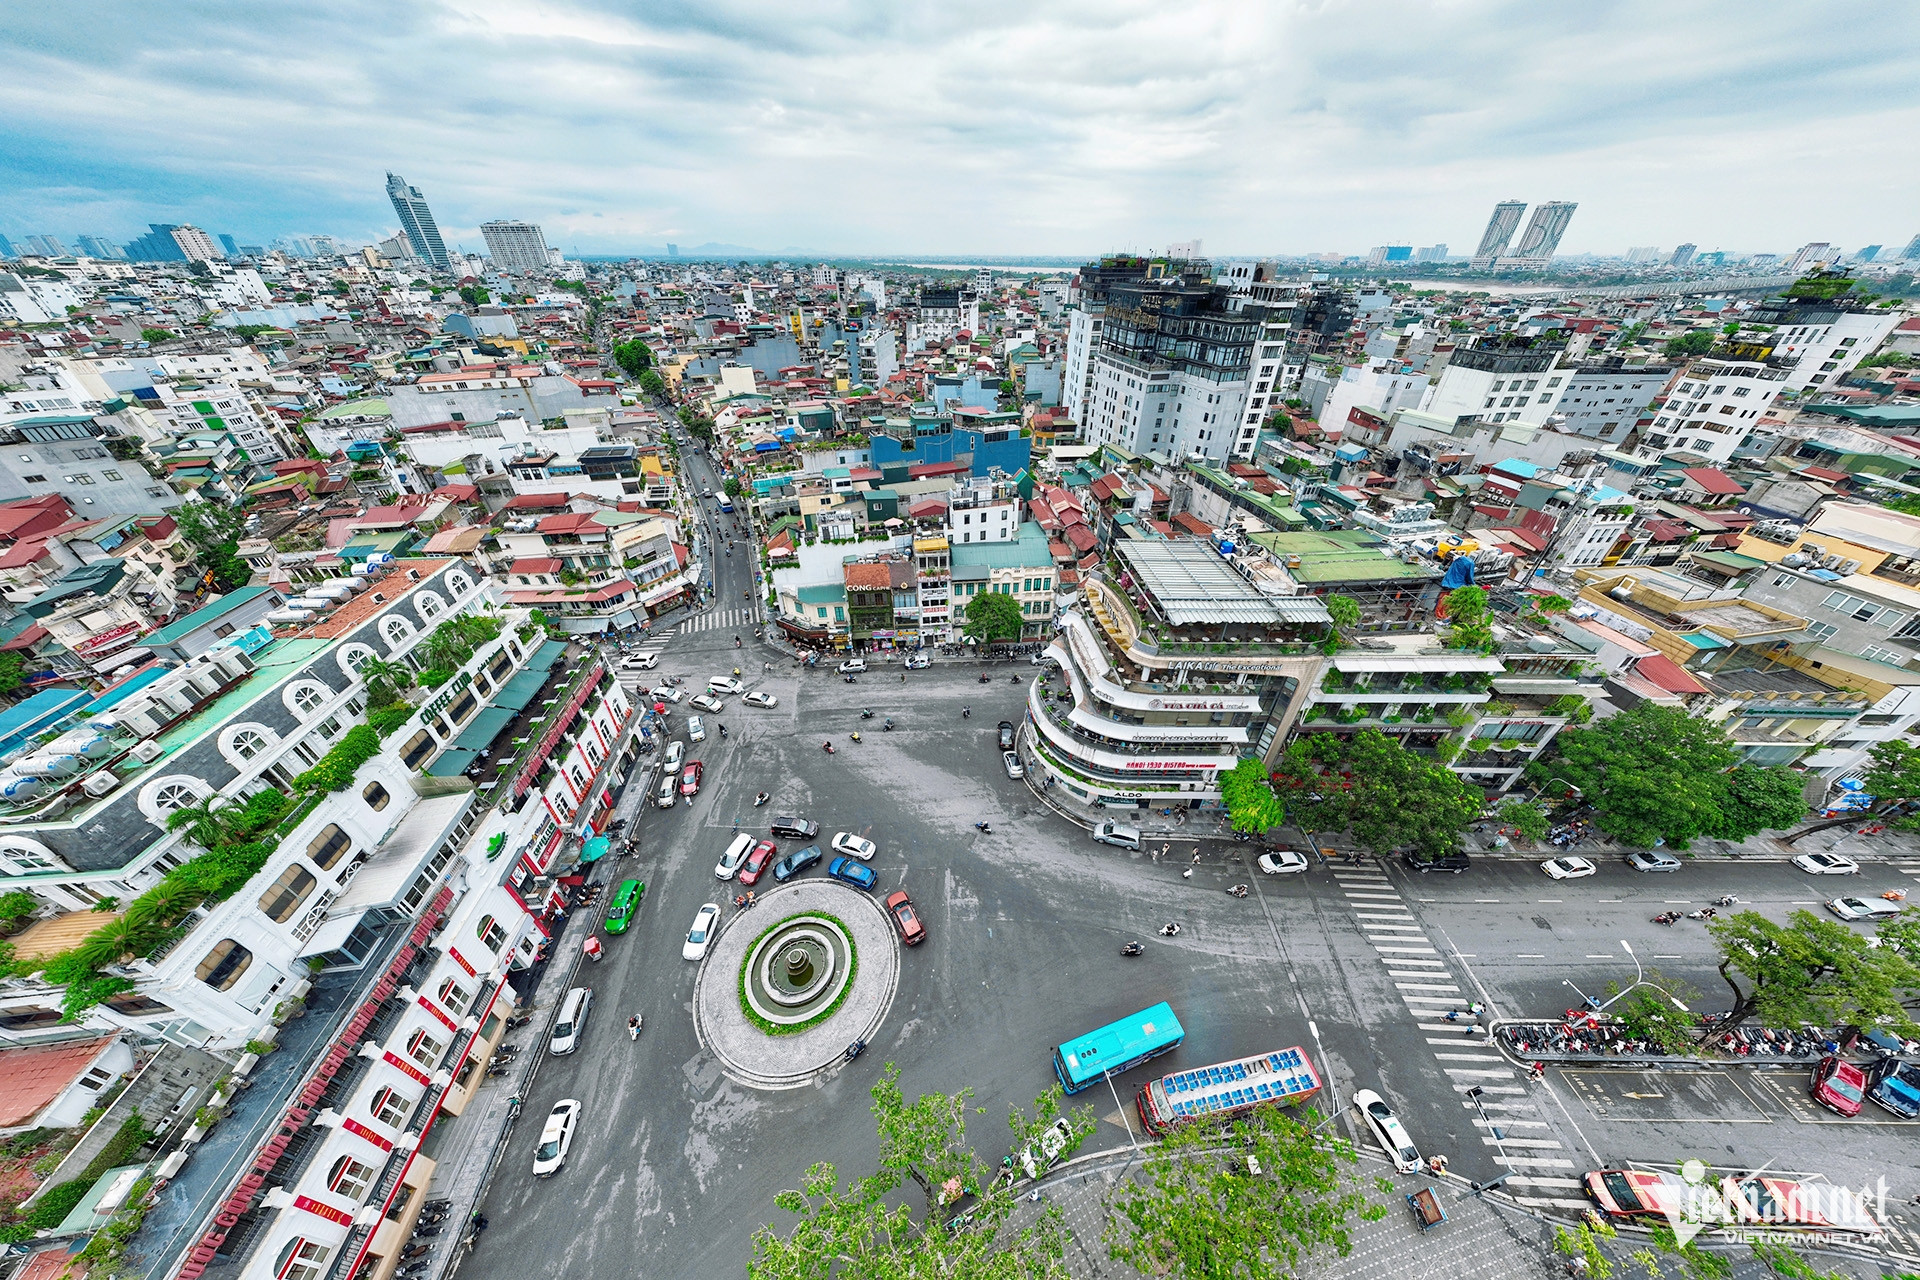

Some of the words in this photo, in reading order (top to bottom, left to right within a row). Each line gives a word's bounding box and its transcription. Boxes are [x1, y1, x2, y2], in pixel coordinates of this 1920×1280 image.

[1168, 661, 1203, 670] LAIKA
[420, 690, 453, 726] COFFEE
[451, 671, 473, 695] CLUB
[174, 1232, 226, 1280] ƯỚC
[214, 1174, 264, 1228] CỘNG
[254, 1134, 293, 1172] HÒA
[282, 1105, 310, 1133] XÃ
[299, 1076, 328, 1107] HỘI
[320, 1044, 349, 1077] CHỦ
[341, 1002, 379, 1047] NGHĨA
[370, 971, 397, 1002] VIỆT
[391, 945, 416, 977] NAM
[410, 910, 438, 947] MUÔN
